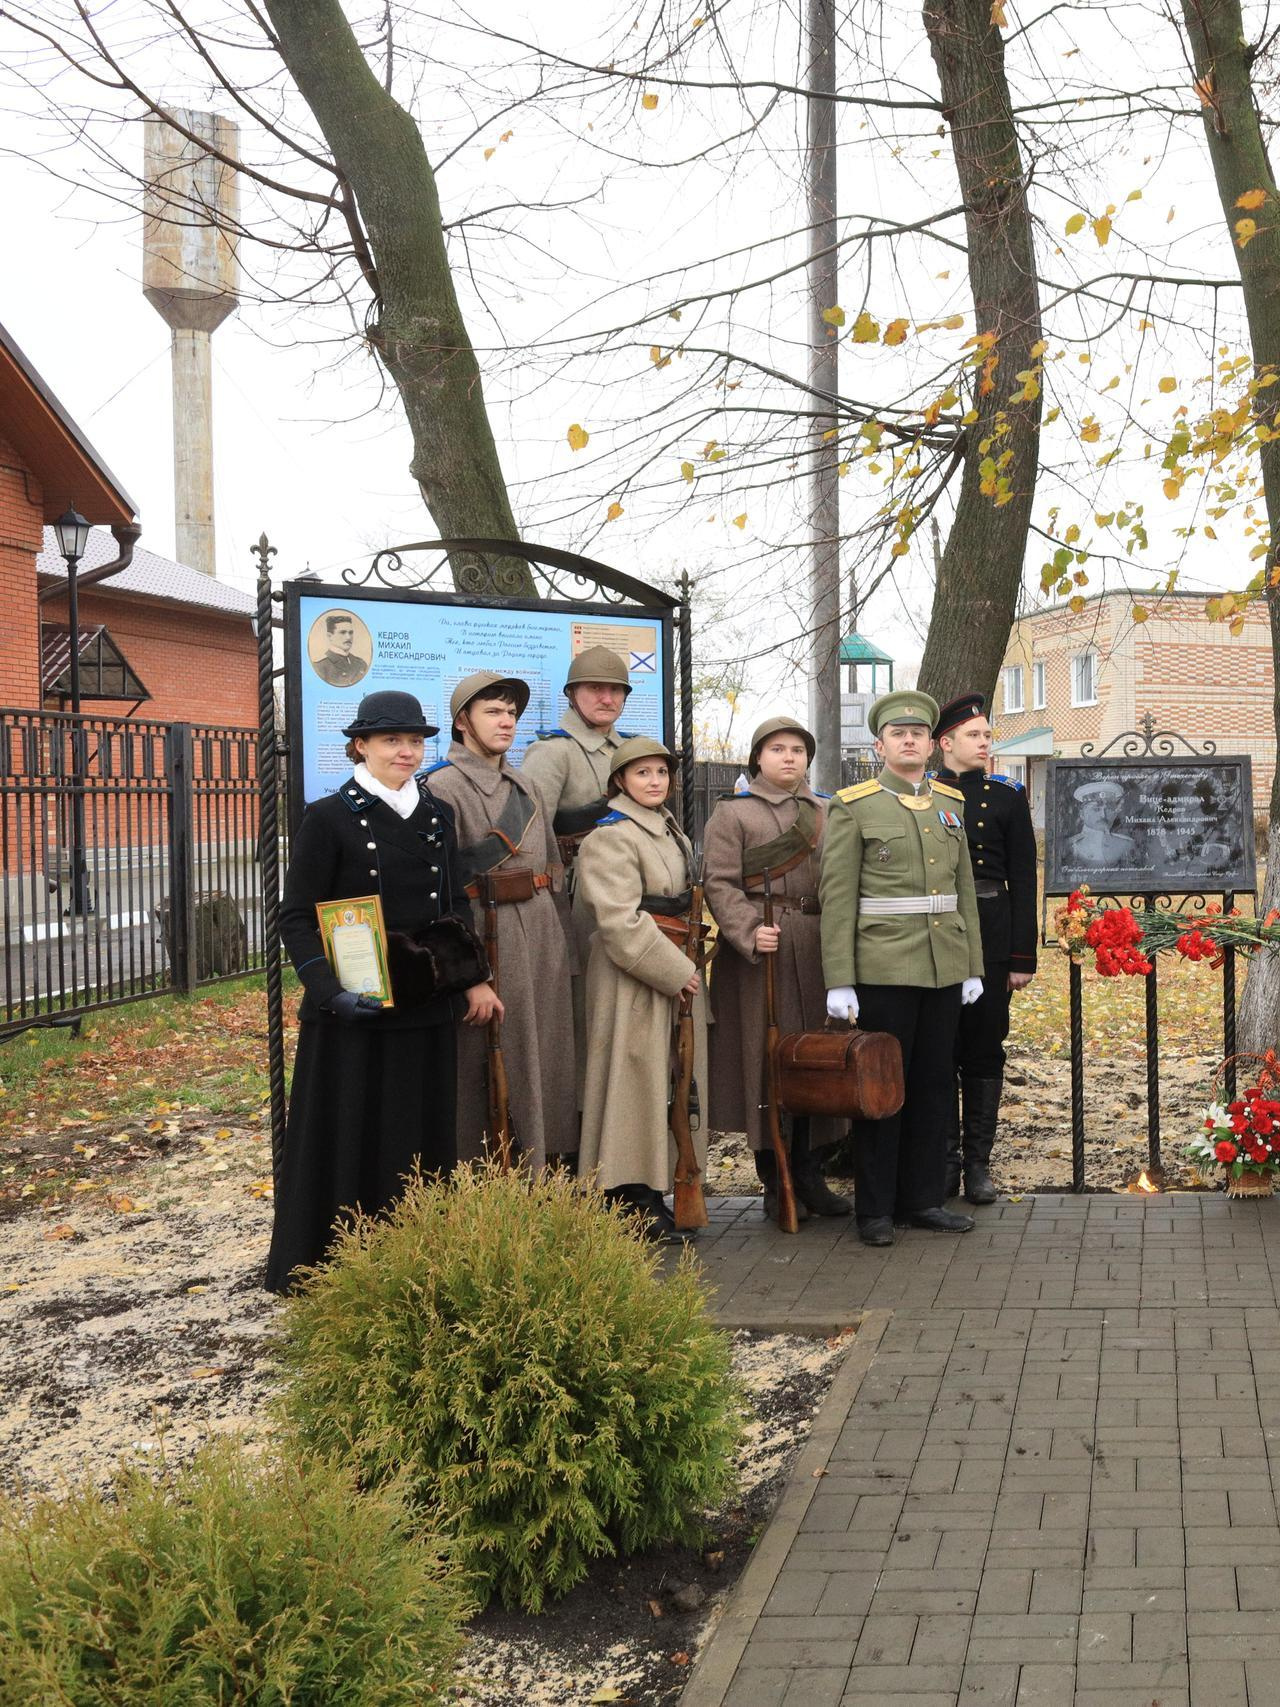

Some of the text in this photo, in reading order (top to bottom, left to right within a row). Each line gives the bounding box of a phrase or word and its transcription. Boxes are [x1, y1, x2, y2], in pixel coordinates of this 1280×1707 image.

[378, 631, 409, 640] КЕДРОВ
[378, 641, 411, 650] МИХАИЛ
[378, 651, 446, 661] АЛЕКСАНДРОВИЧ
[495, 668, 515, 676] между
[1139, 795, 1205, 805] Вице-адмирал
[1147, 828, 1166, 836] 1878
[1176, 827, 1196, 836] 1945
